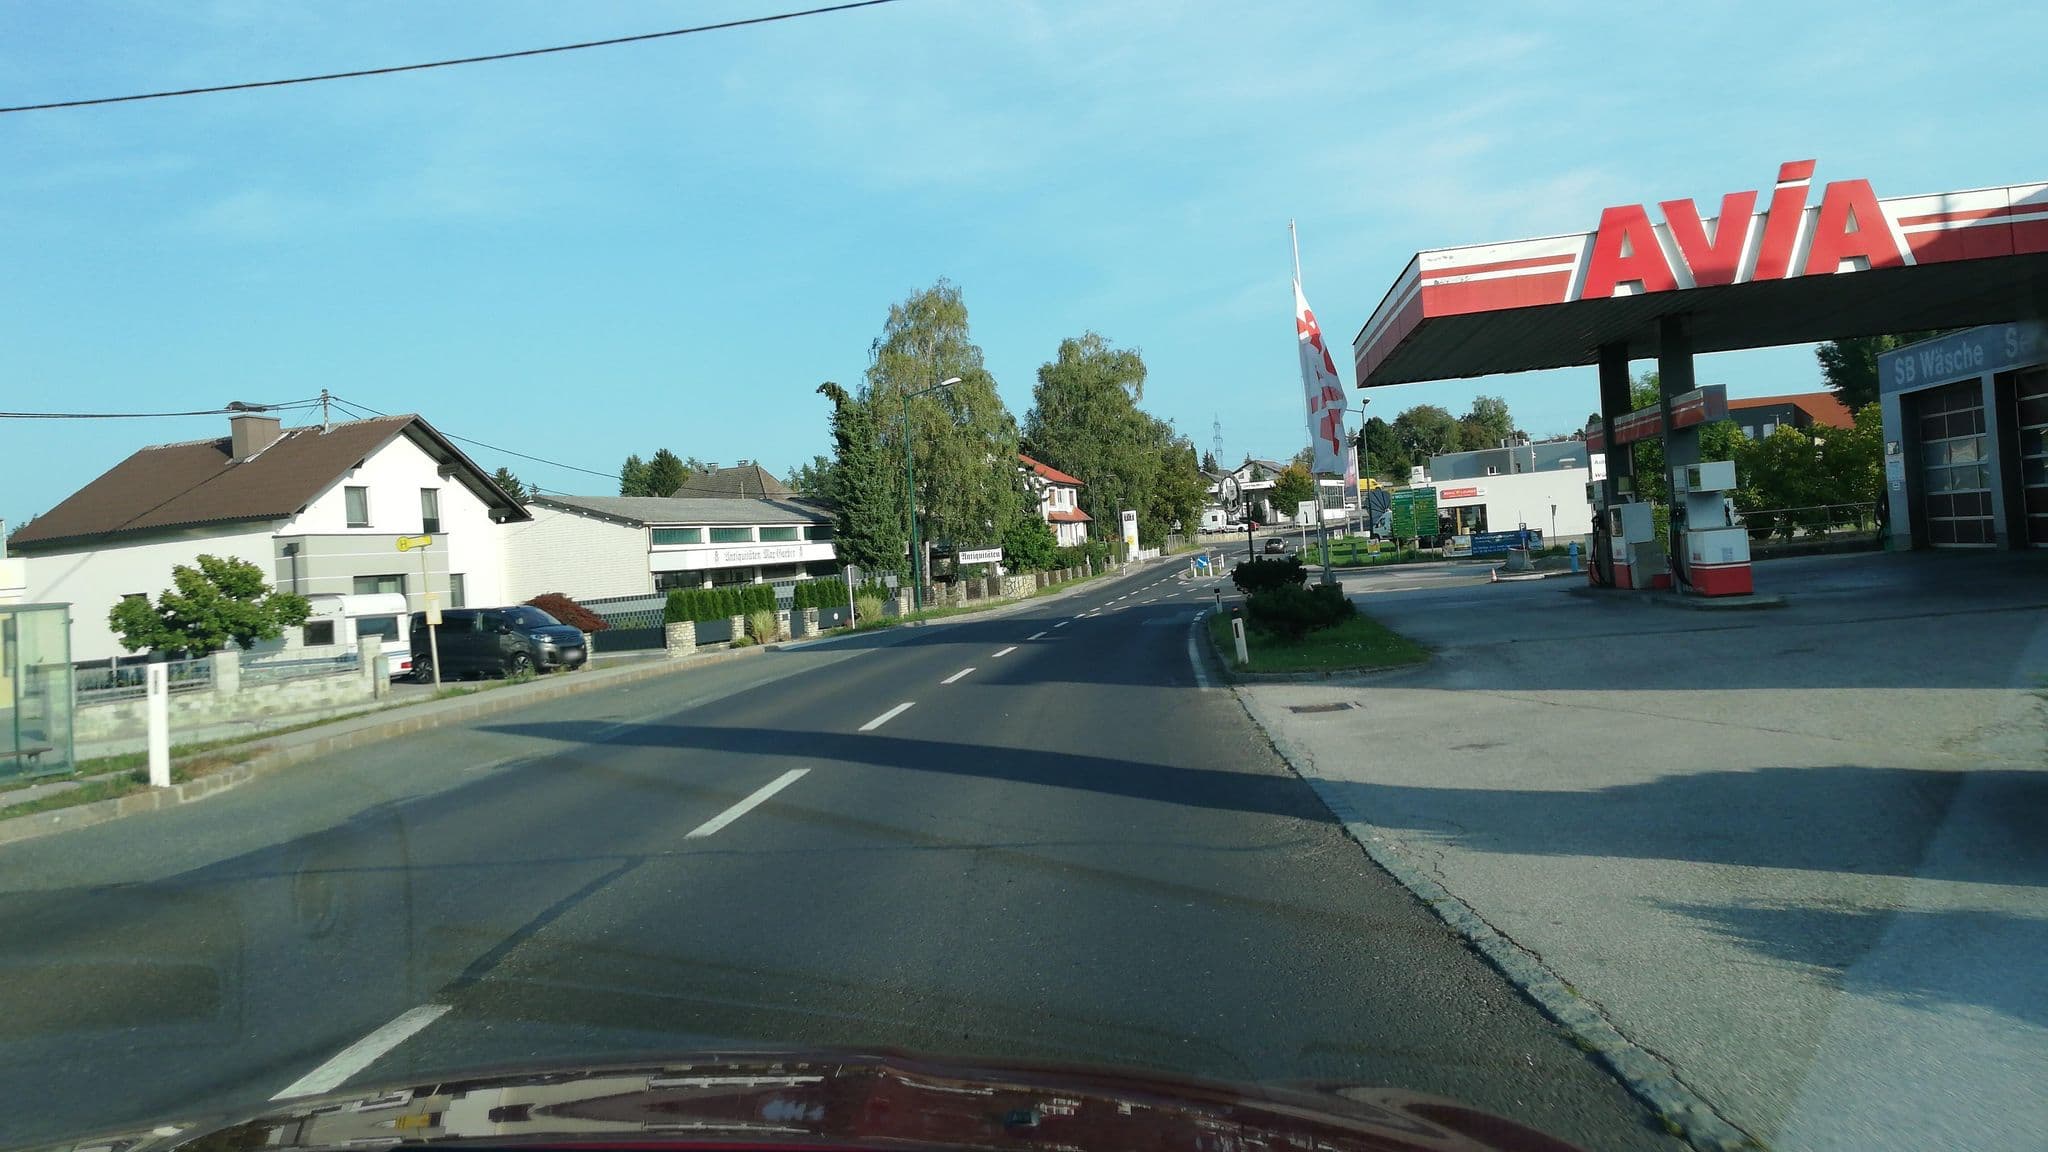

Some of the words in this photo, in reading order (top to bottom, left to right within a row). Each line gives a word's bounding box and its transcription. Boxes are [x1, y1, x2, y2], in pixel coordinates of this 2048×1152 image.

[1895, 355, 1915, 385] SB
[1919, 340, 1984, 379] Wäsche
[960, 551, 1001, 561] Antiquitäten
